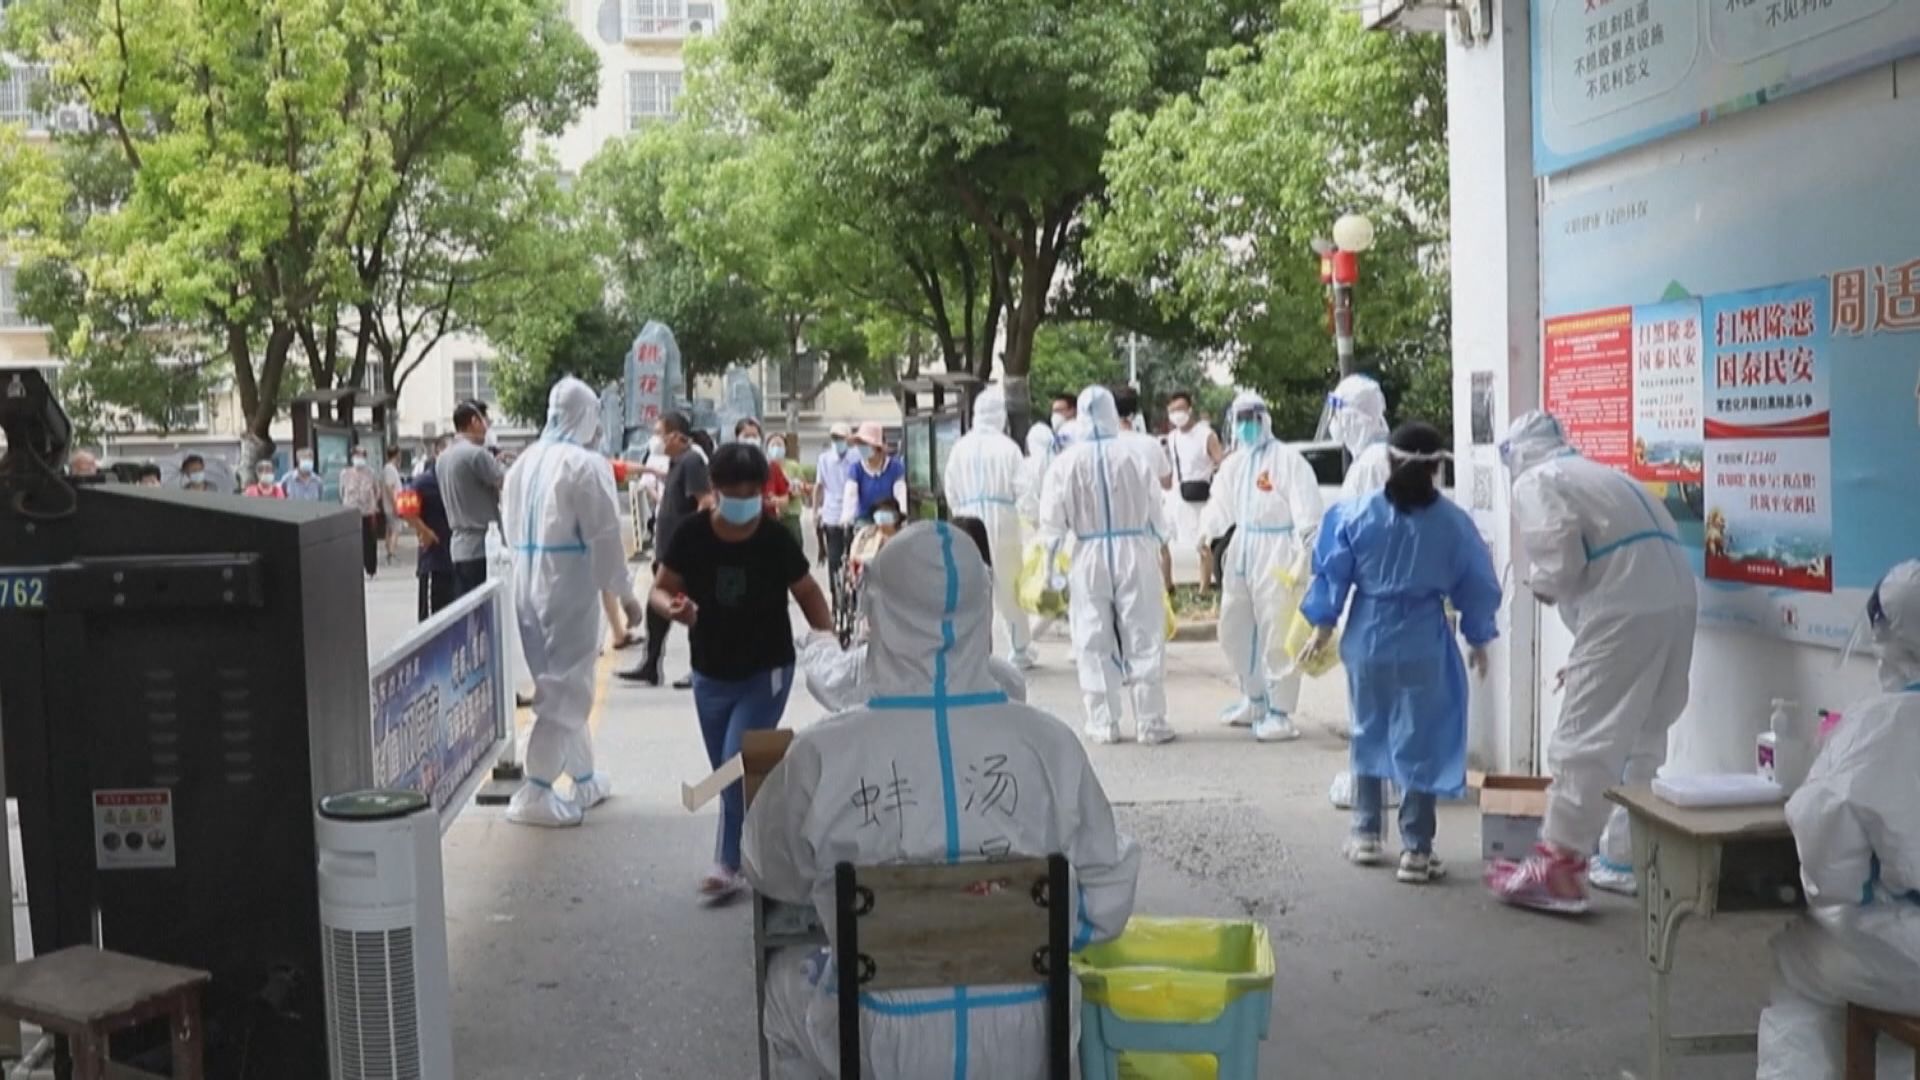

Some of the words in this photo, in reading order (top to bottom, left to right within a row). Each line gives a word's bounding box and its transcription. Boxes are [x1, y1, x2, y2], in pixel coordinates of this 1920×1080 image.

[1586, 57, 1650, 100] 不见利忘义
[1639, 318, 1697, 347] 扫黑除恶
[1716, 299, 1814, 346] 扫黑除恶
[1639, 345, 1697, 371] 国泰民安
[1717, 344, 1814, 389] 国泰民安
